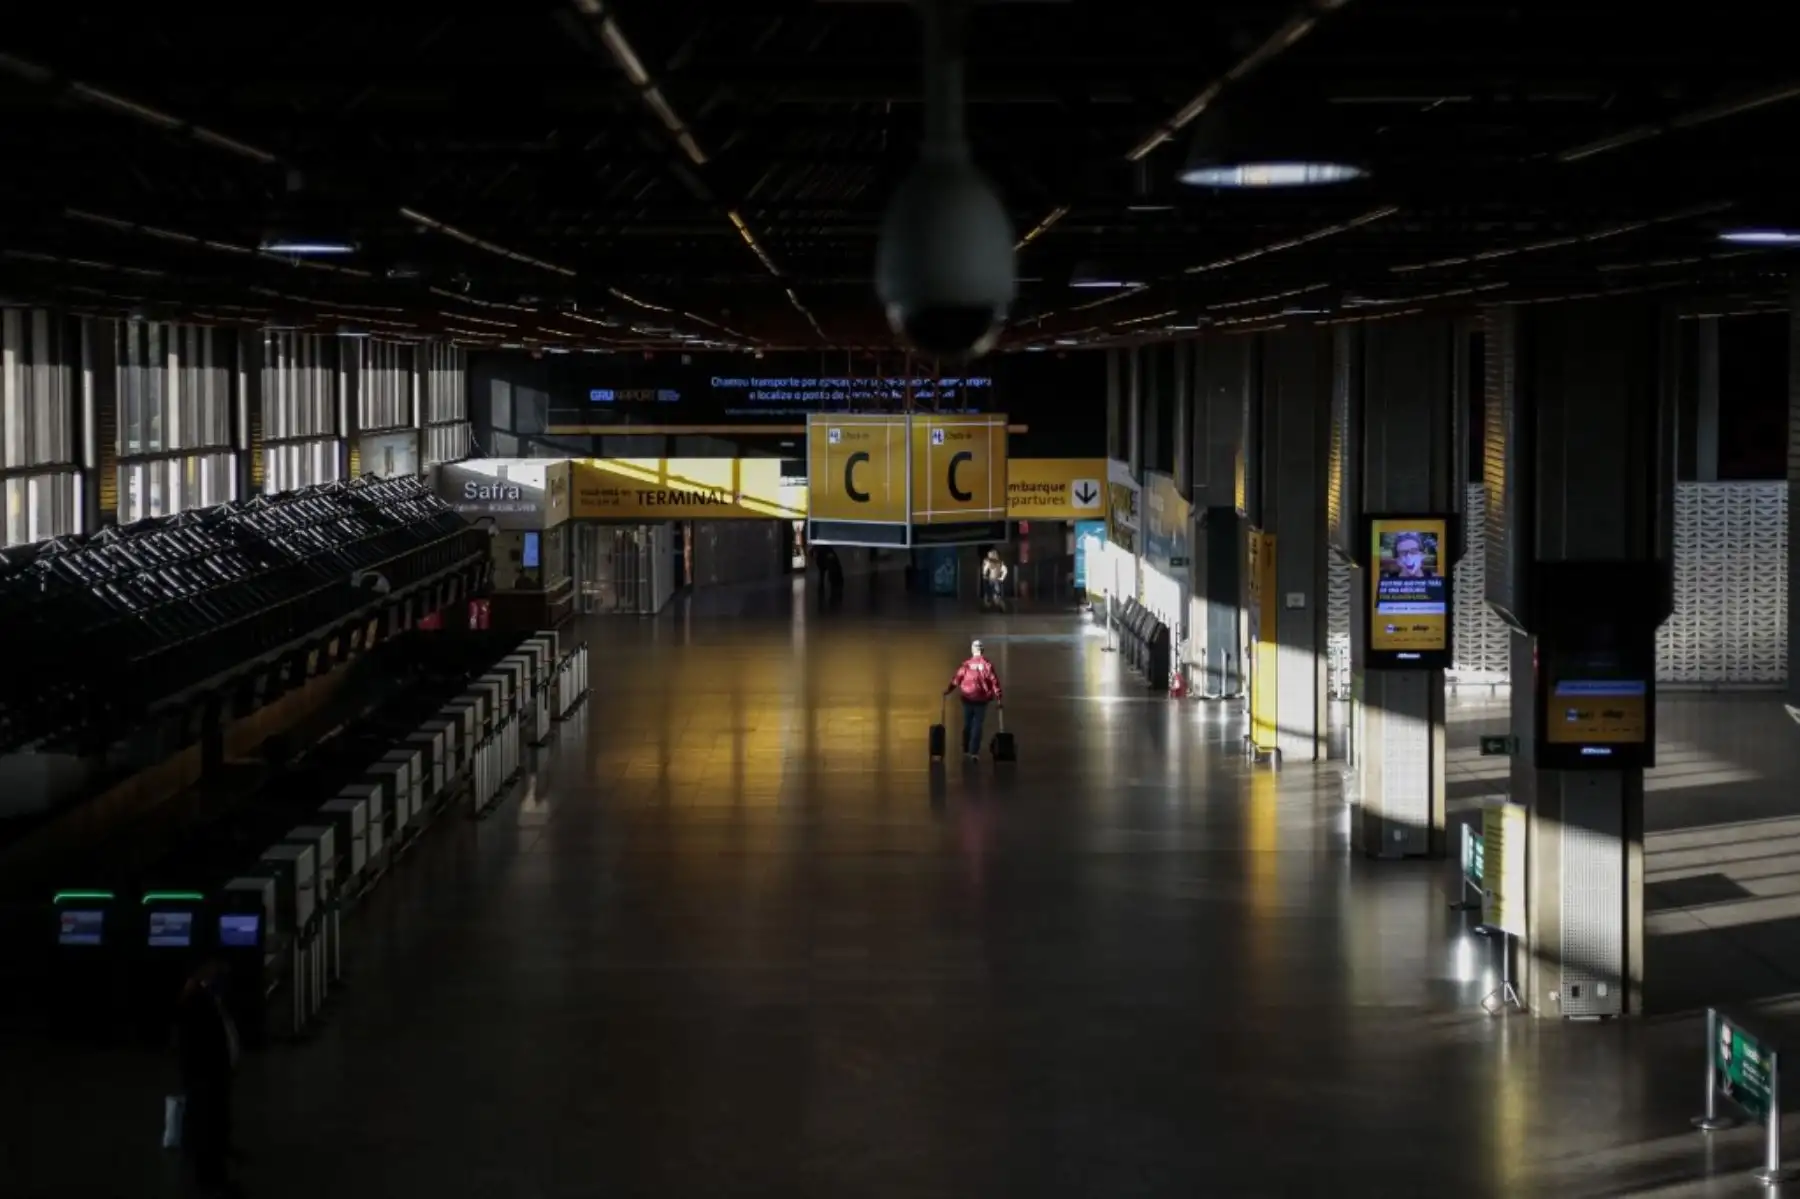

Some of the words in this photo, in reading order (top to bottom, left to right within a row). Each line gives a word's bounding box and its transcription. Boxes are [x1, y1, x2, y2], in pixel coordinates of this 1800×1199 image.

[845, 452, 870, 503] C
[948, 451, 972, 501] C
[464, 480, 520, 500] Safra
[1008, 481, 1066, 495] mbarque
[635, 489, 728, 506] TERMINAL
[1008, 495, 1066, 508] partures
